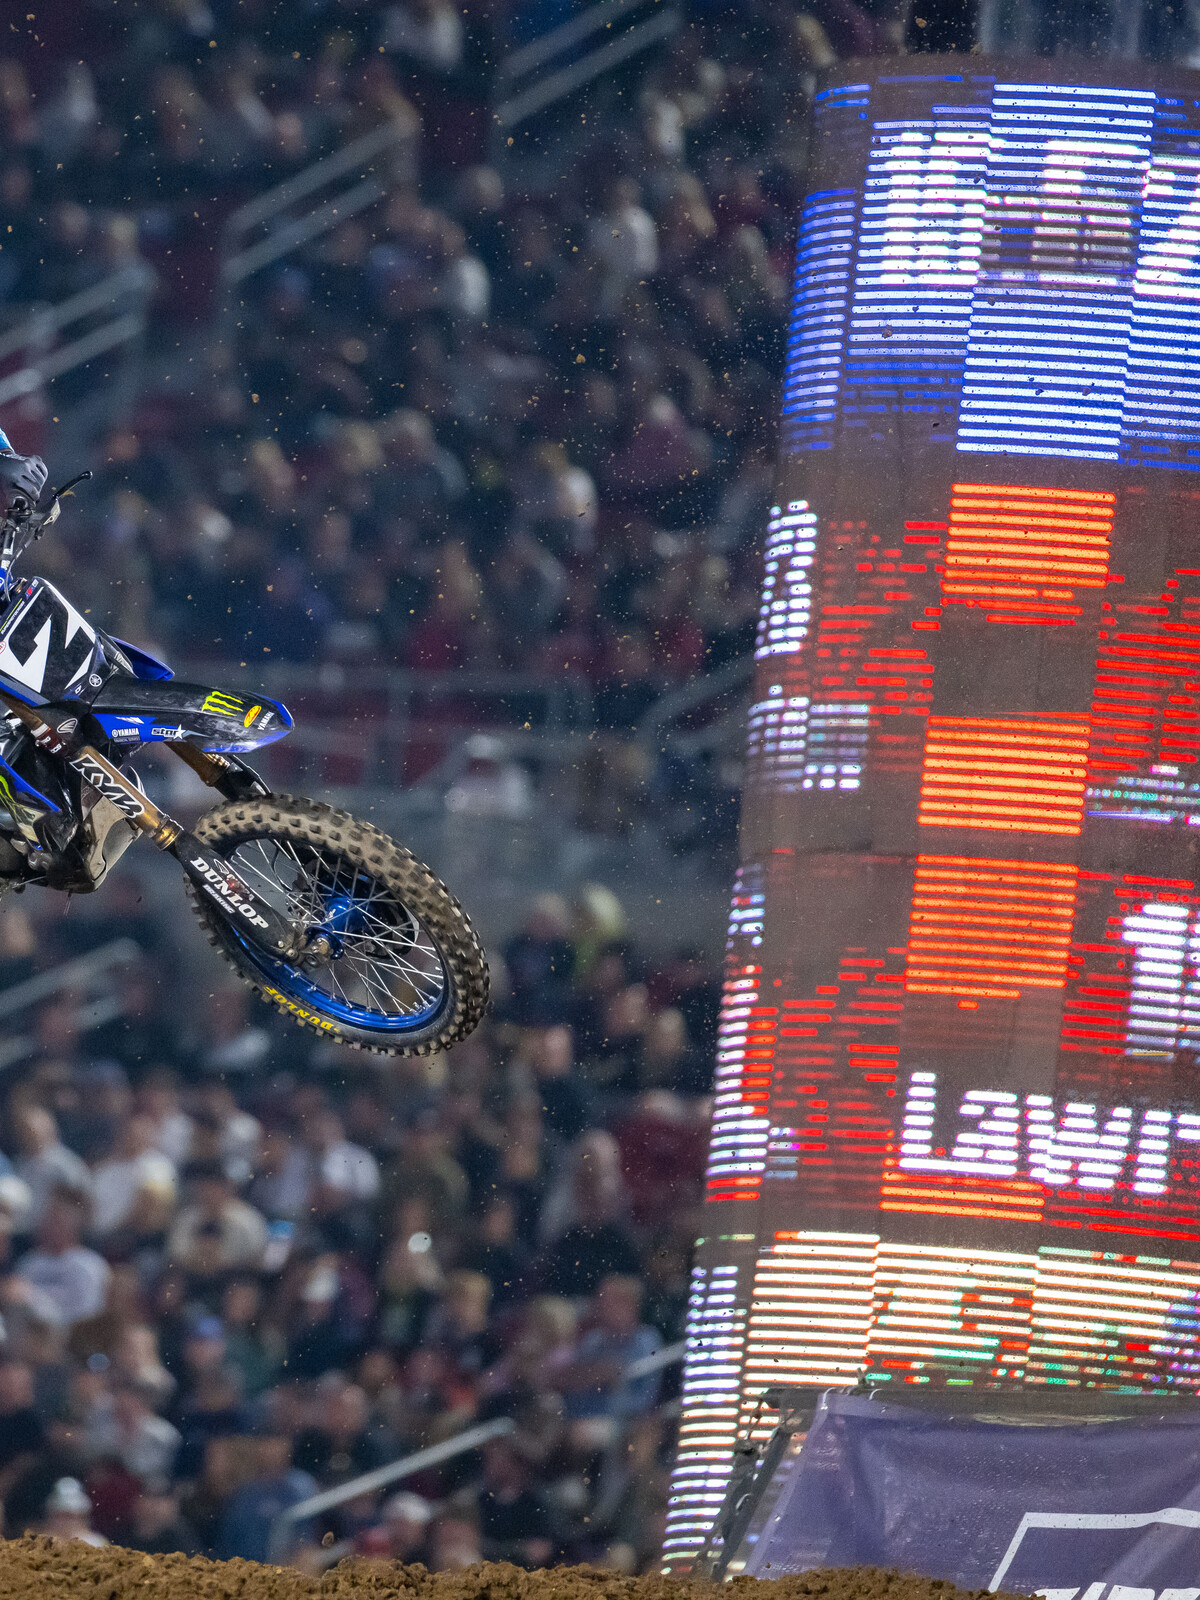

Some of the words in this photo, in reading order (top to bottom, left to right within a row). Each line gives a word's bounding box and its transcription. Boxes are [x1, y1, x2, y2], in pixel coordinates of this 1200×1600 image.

[118, 727, 140, 737] YAMAHA
[257, 711, 275, 730] YAMAHA
[190, 856, 269, 929] DUNLOP
[203, 884, 236, 914] BRAKING
